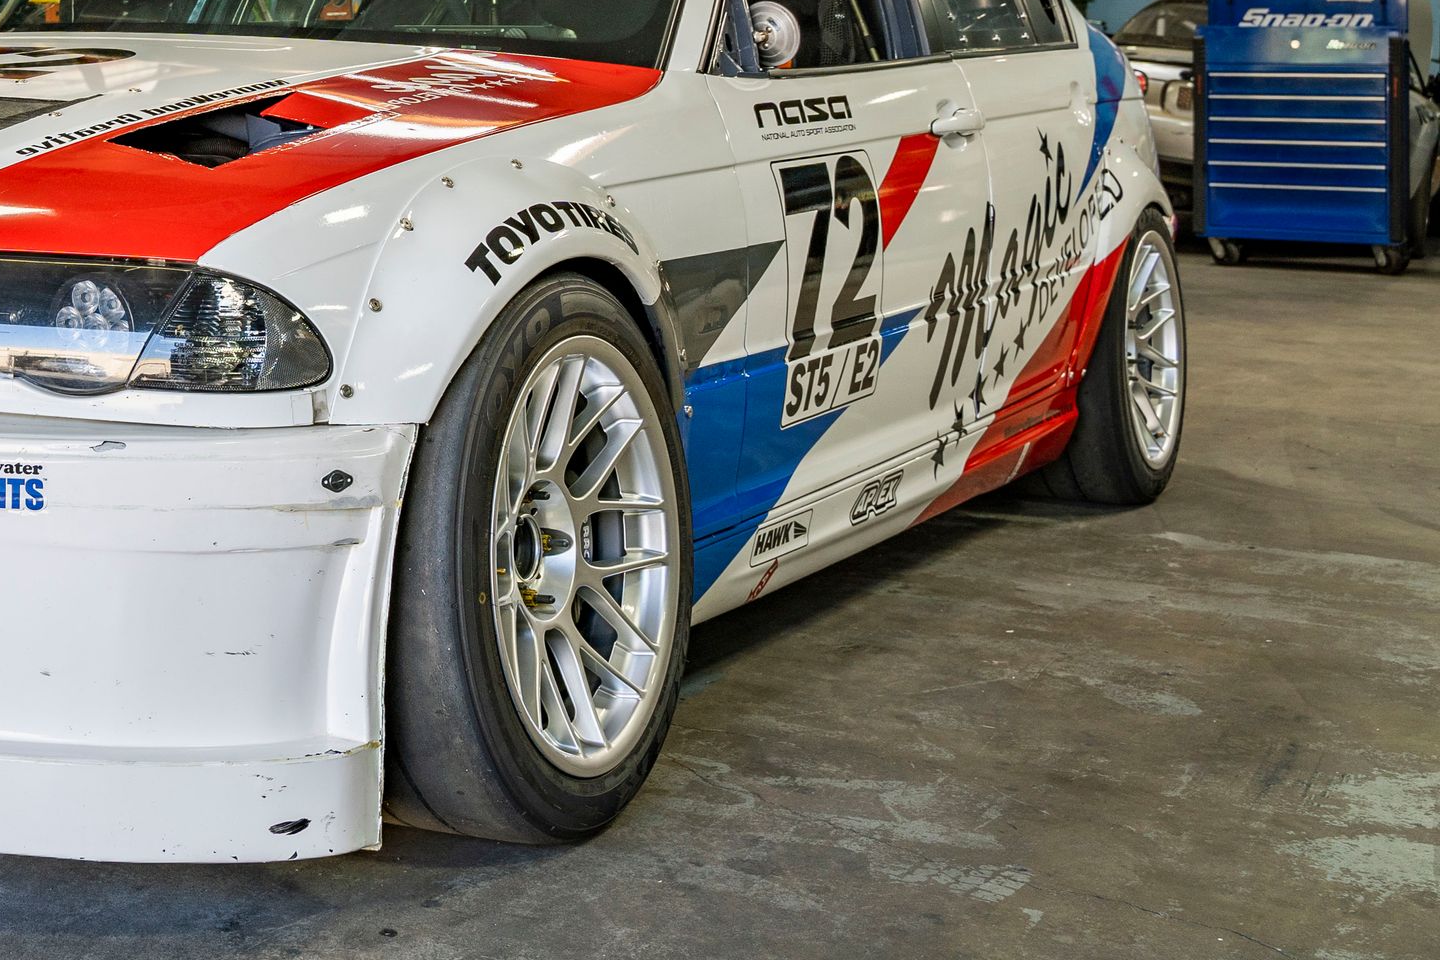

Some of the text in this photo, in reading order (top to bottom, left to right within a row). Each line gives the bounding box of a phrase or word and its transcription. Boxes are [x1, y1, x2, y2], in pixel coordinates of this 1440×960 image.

[761, 123, 856, 141] NATIONAL AUTO SPORT ASSOCIATION
[464, 201, 640, 286] TOYO TIRES
[779, 155, 879, 362] 72
[926, 140, 1072, 410] Magic
[1038, 168, 1123, 323] DEVELOPED
[786, 354, 834, 417] ST5
[848, 339, 879, 395] E2
[754, 521, 794, 556] HAWK
